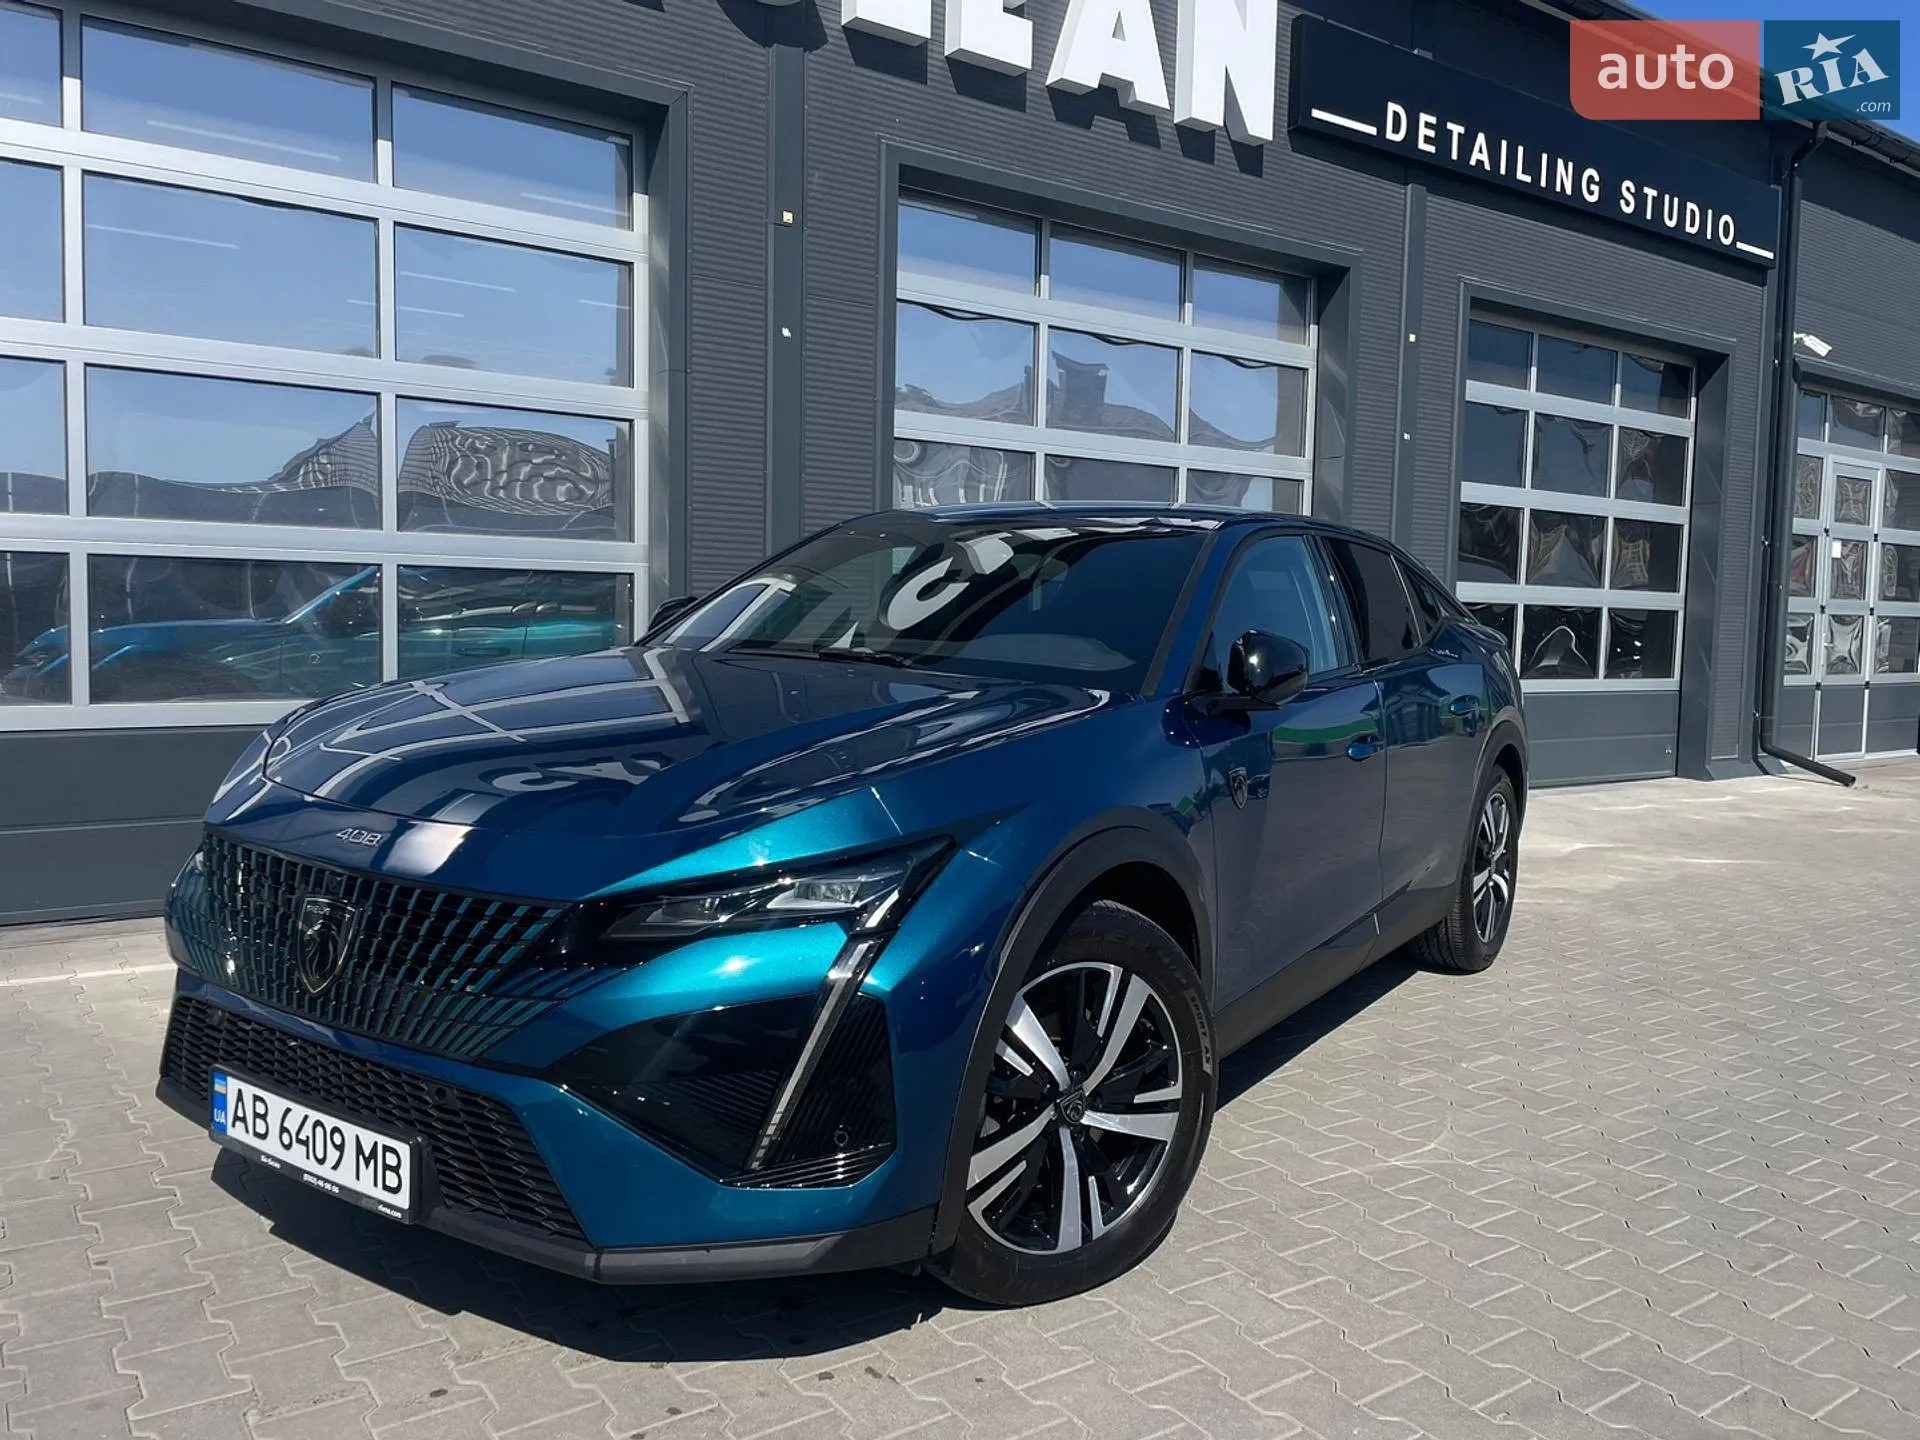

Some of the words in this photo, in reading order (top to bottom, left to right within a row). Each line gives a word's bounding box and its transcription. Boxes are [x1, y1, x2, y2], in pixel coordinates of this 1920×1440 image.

[1385, 101, 1600, 203] DETAILING
[1619, 180, 1736, 246] STUDIO
[336, 829, 382, 845] 408
[1190, 995, 1208, 1037] SPORT
[214, 1109, 226, 1124] UA
[231, 1088, 269, 1140] AB
[279, 1107, 345, 1170] 6409
[355, 1134, 402, 1195] MB
